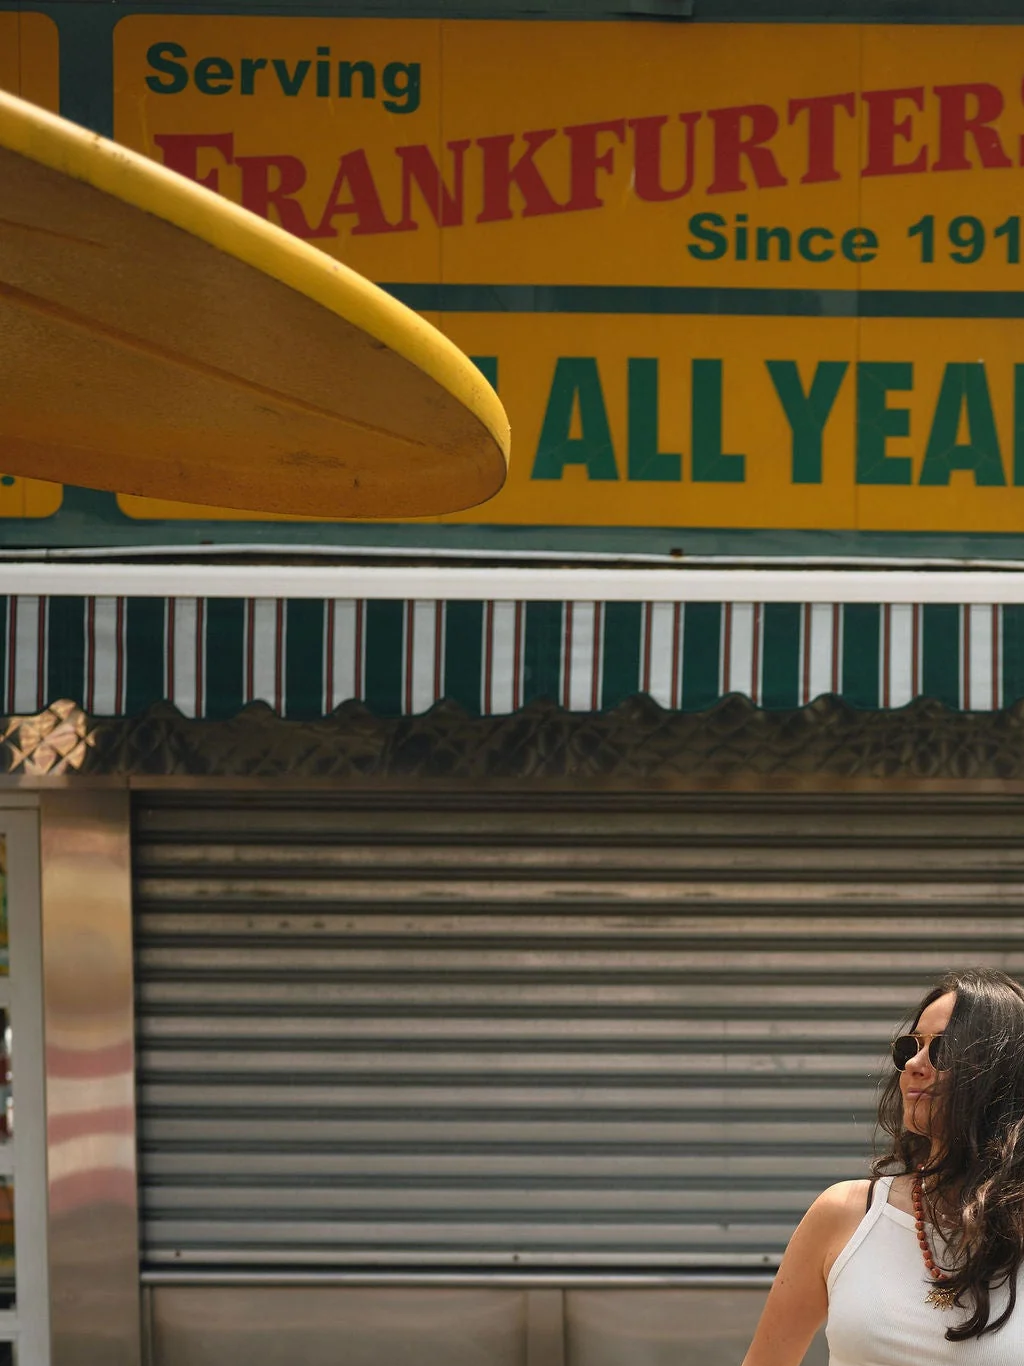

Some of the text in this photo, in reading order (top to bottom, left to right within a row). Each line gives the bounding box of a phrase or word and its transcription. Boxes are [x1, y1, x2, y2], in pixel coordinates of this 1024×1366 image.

[145, 42, 422, 114] Serving
[687, 212, 879, 263] Since
[530, 357, 746, 483] ALL
